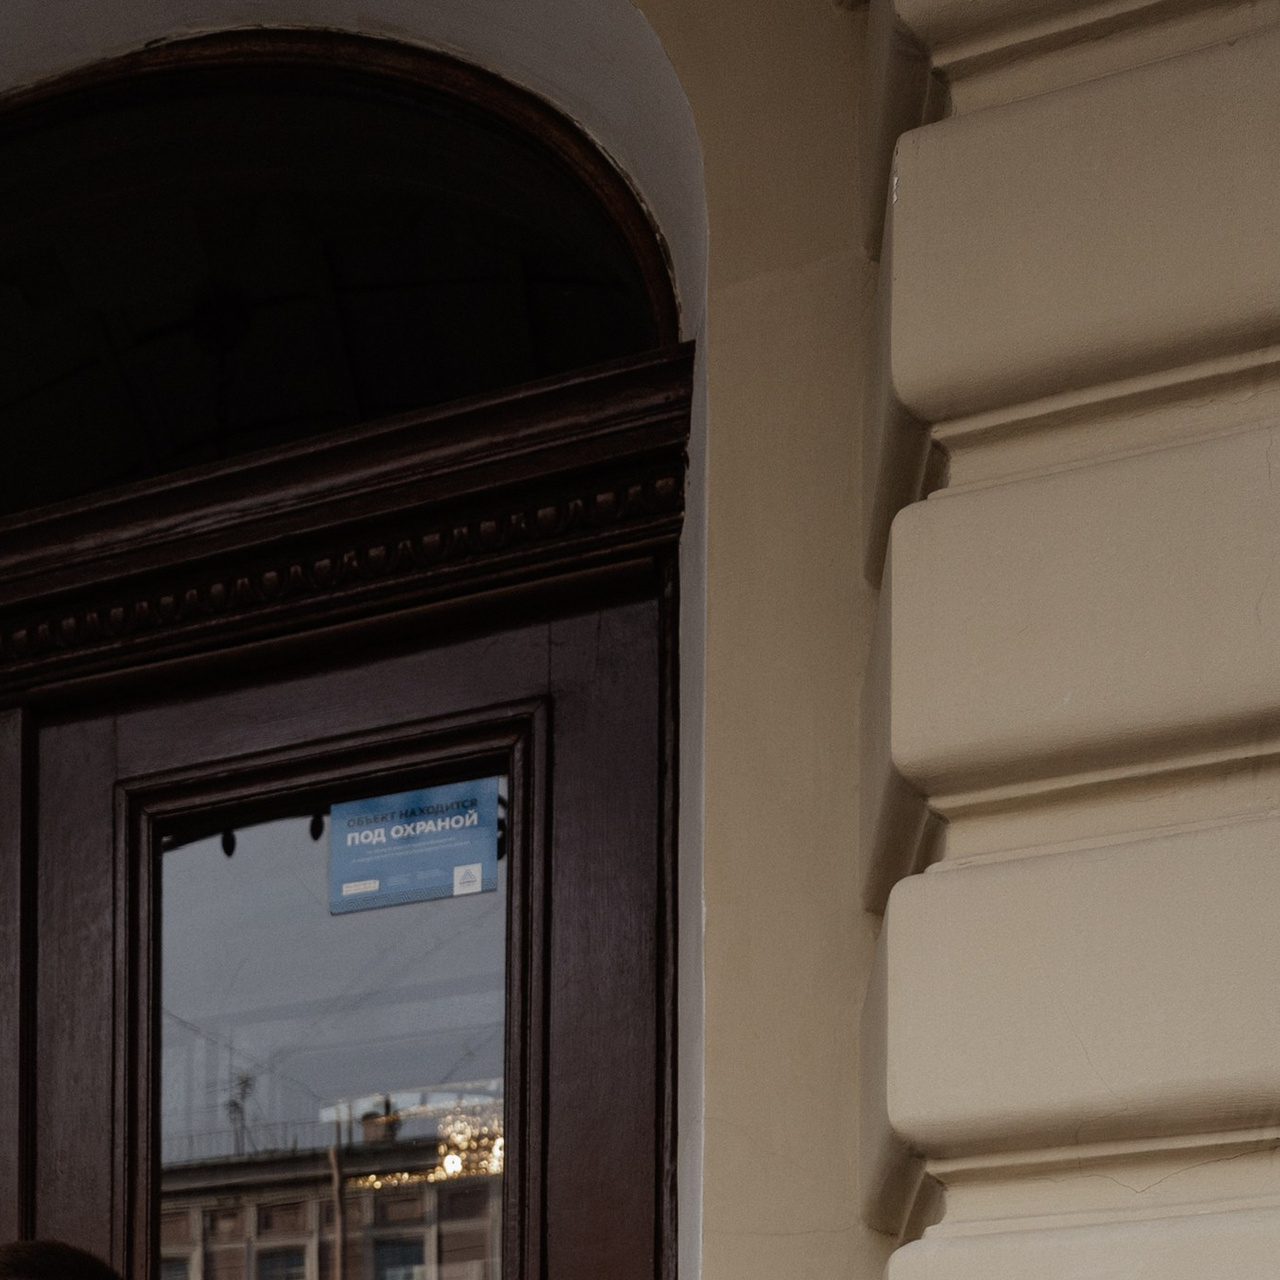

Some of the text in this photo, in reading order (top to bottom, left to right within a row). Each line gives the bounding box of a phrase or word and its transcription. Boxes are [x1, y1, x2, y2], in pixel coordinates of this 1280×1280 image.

[346, 827, 386, 846] ПОД
[390, 809, 478, 838] ОХРАНОЙ
[347, 798, 478, 827] ОБЪЕКТ НАХОДИТСЯ
